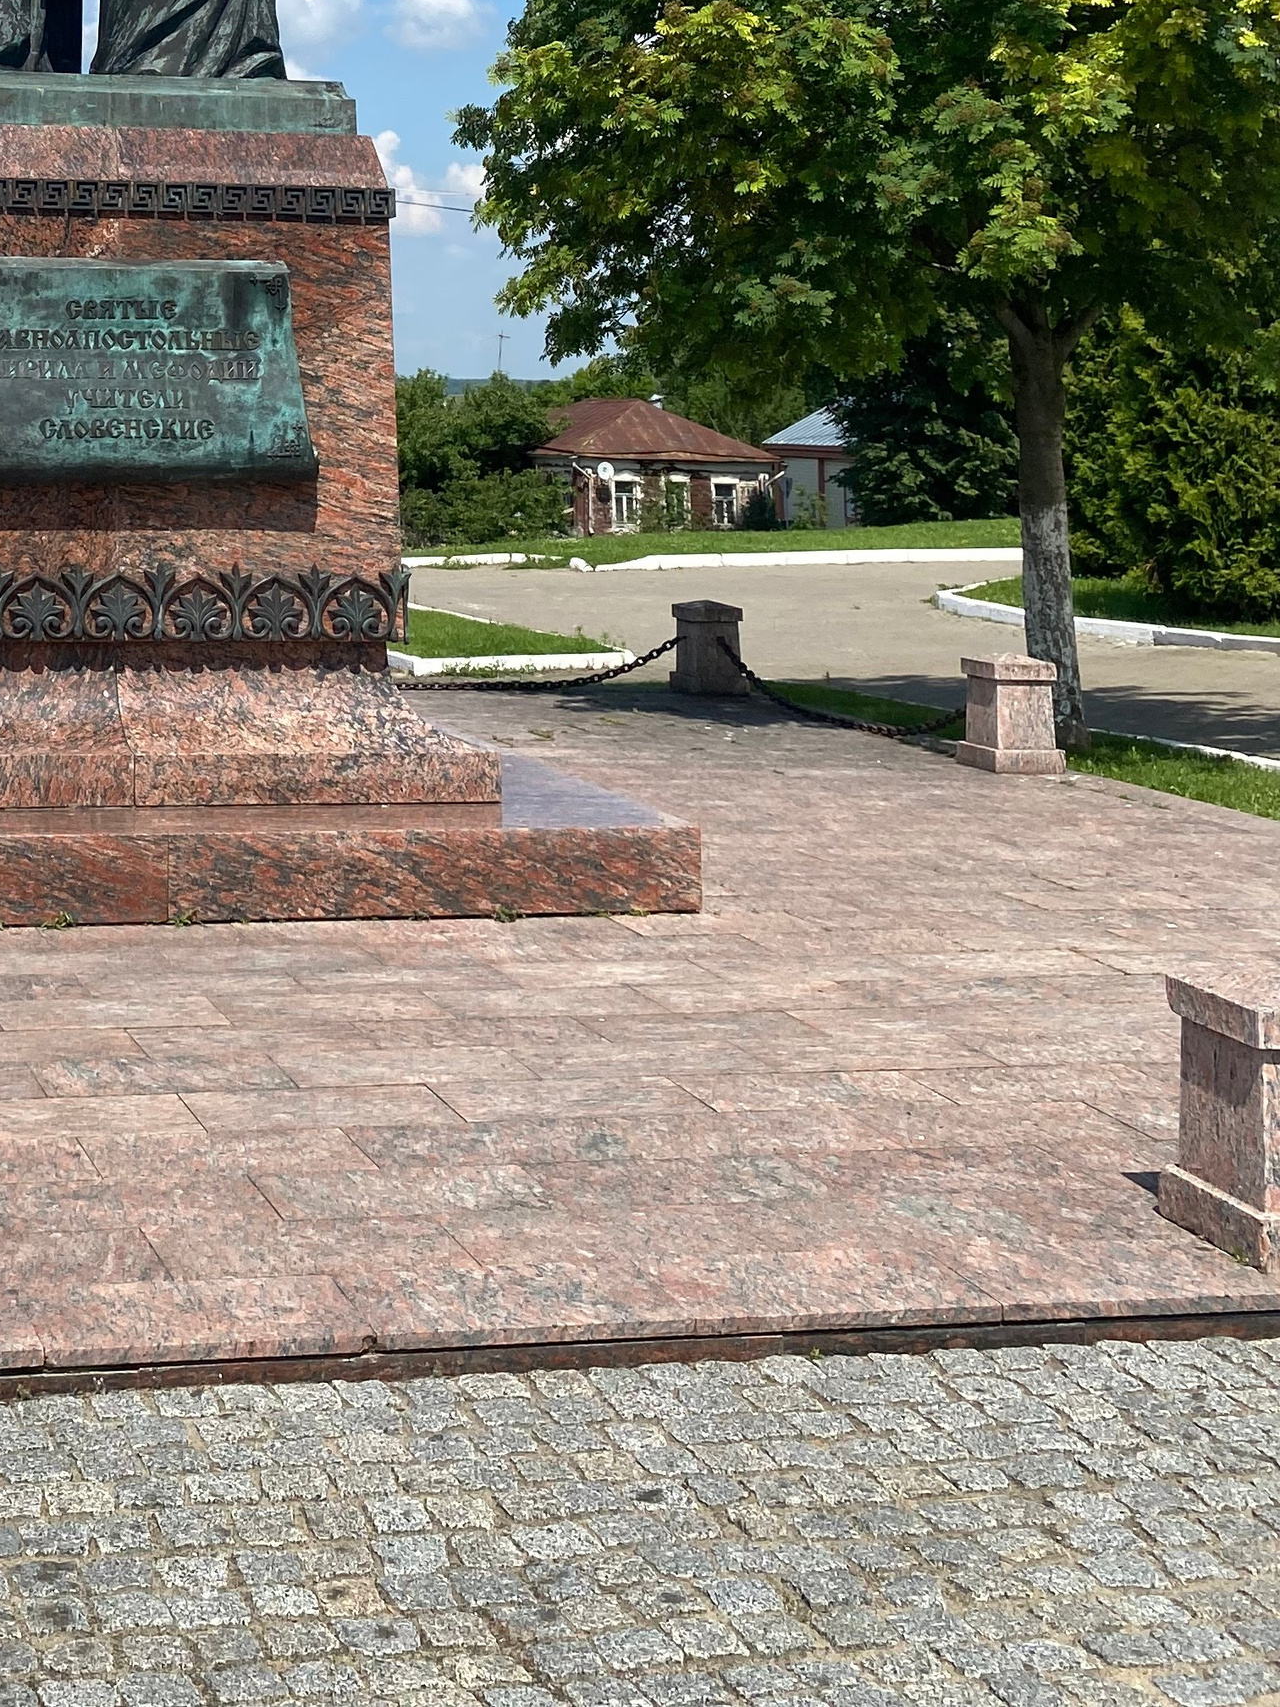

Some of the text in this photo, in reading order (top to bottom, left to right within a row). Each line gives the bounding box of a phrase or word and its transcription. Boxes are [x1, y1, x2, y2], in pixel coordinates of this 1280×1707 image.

[64, 299, 179, 321] СВЯТЫЕ
[97, 359, 117, 379] И
[64, 388, 190, 415] УЧИТЕЛИ
[37, 417, 216, 440] СЛОВЕНСКИЕ
